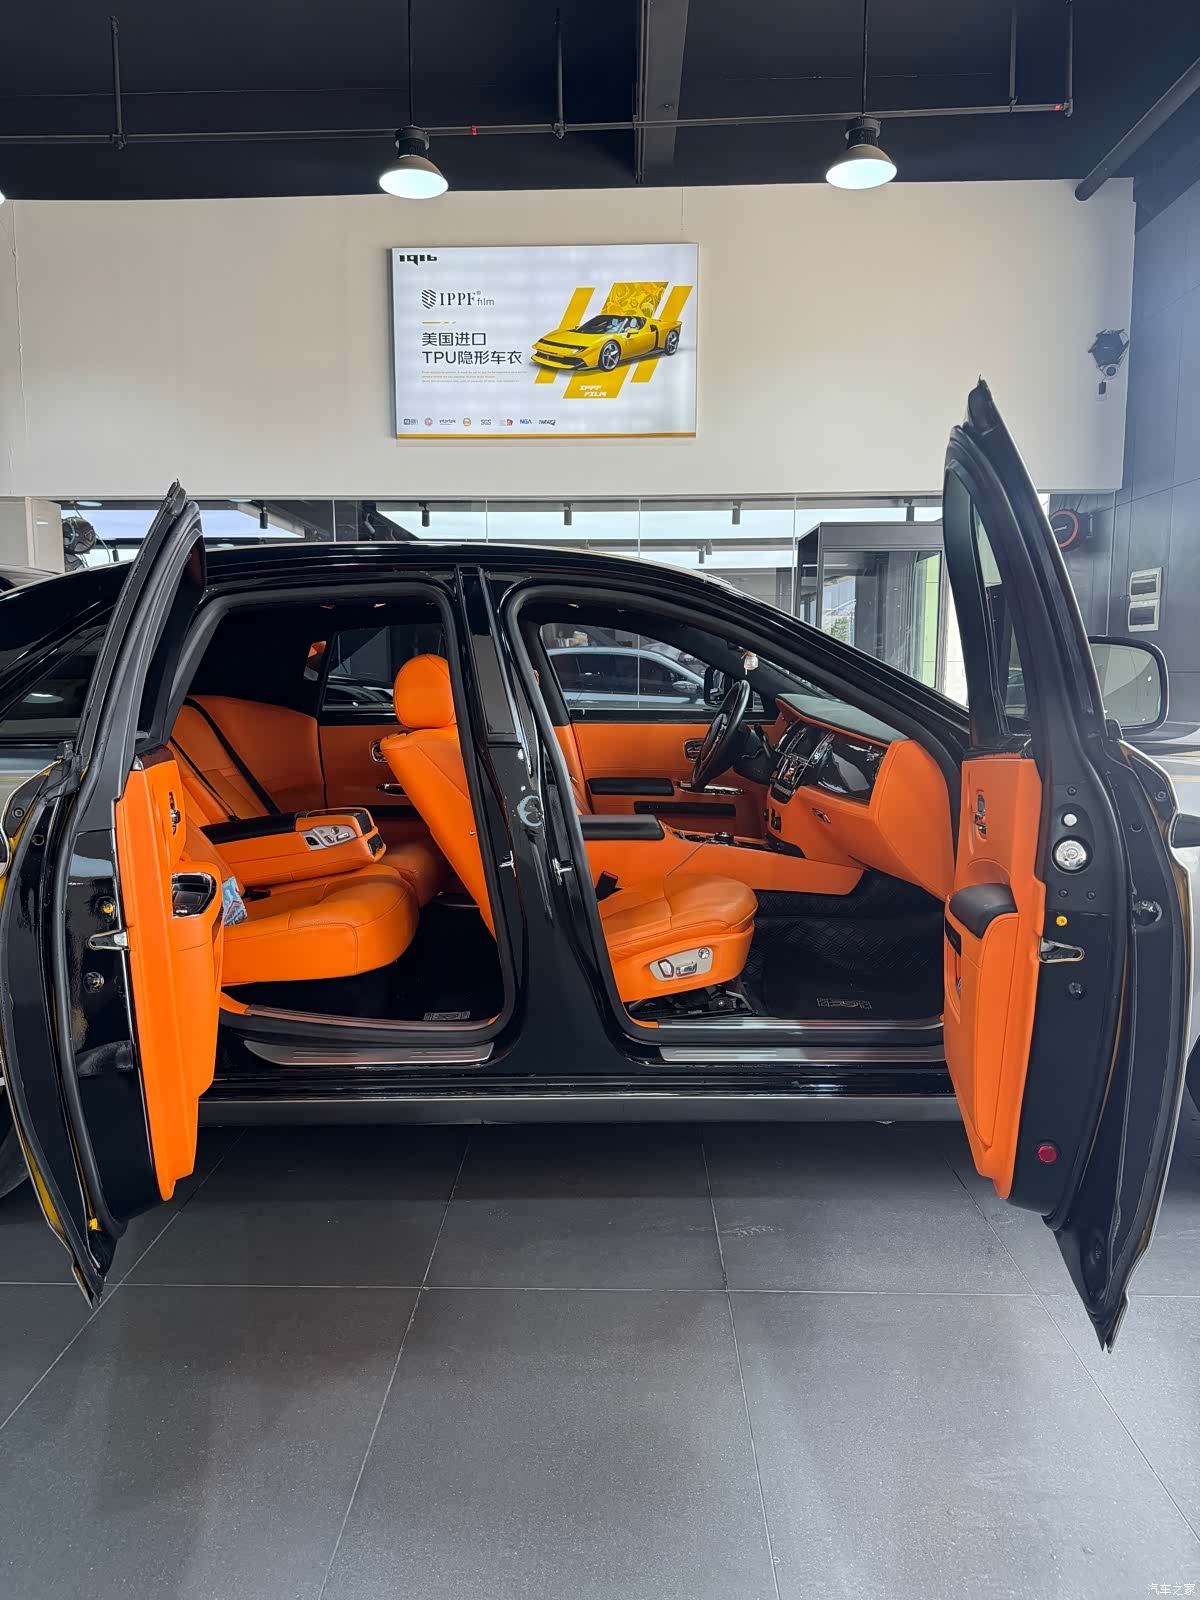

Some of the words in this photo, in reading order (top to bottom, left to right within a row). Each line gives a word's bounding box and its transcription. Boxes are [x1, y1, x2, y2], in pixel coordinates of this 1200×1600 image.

[477, 298, 495, 306] film
[422, 332, 487, 347] 美国进口
[422, 350, 523, 365] TPU隐形车衣
